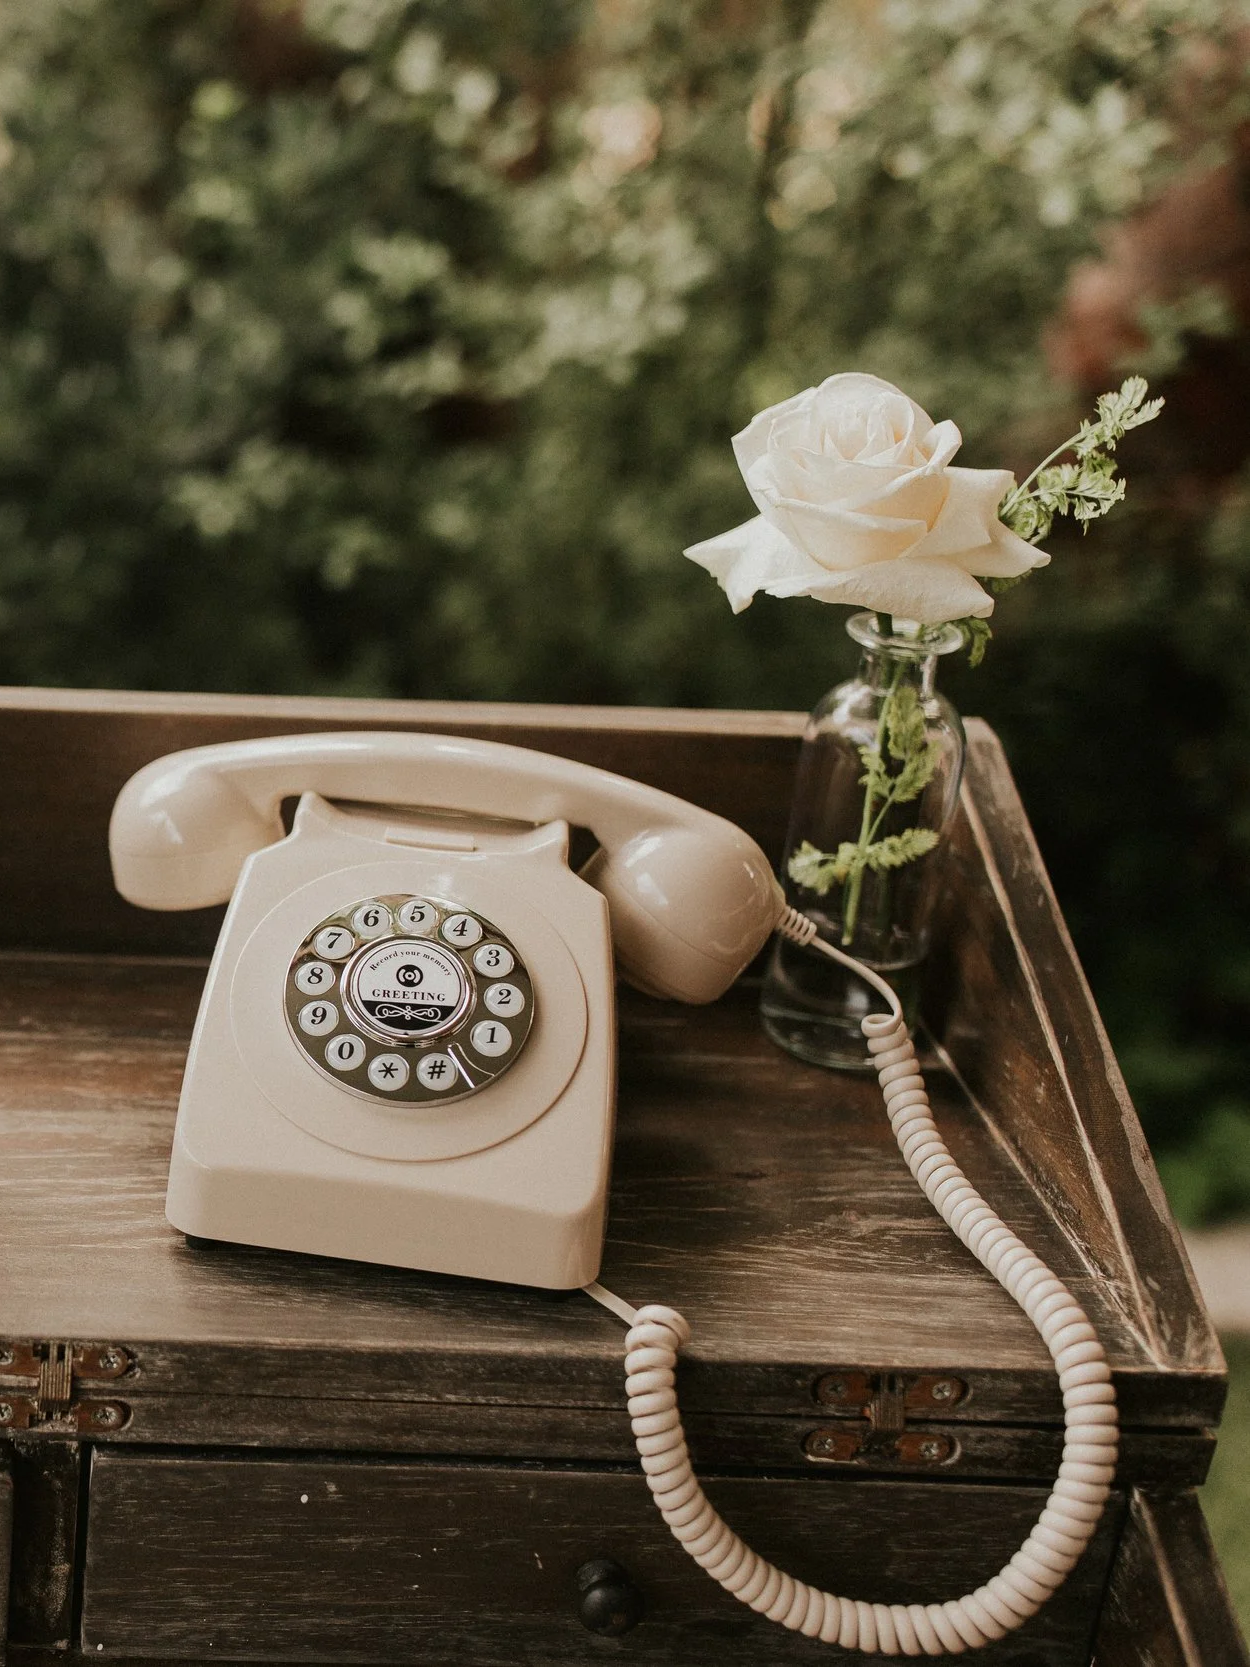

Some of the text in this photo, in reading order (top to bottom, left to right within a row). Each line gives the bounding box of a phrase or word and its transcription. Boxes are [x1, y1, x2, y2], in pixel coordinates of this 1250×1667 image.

[363, 909, 380, 927] 6
[409, 905, 426, 923] 5
[452, 918, 468, 937] 4
[326, 931, 343, 949] 7
[369, 950, 452, 976] Record your memory
[485, 949, 501, 967] 3
[307, 967, 324, 985] 8
[371, 988, 446, 1002] GREETING
[497, 988, 512, 1005] 2
[310, 1006, 327, 1025] 9
[485, 1026, 498, 1044] 1
[337, 1041, 355, 1060] 0
[427, 1060, 447, 1080] #
